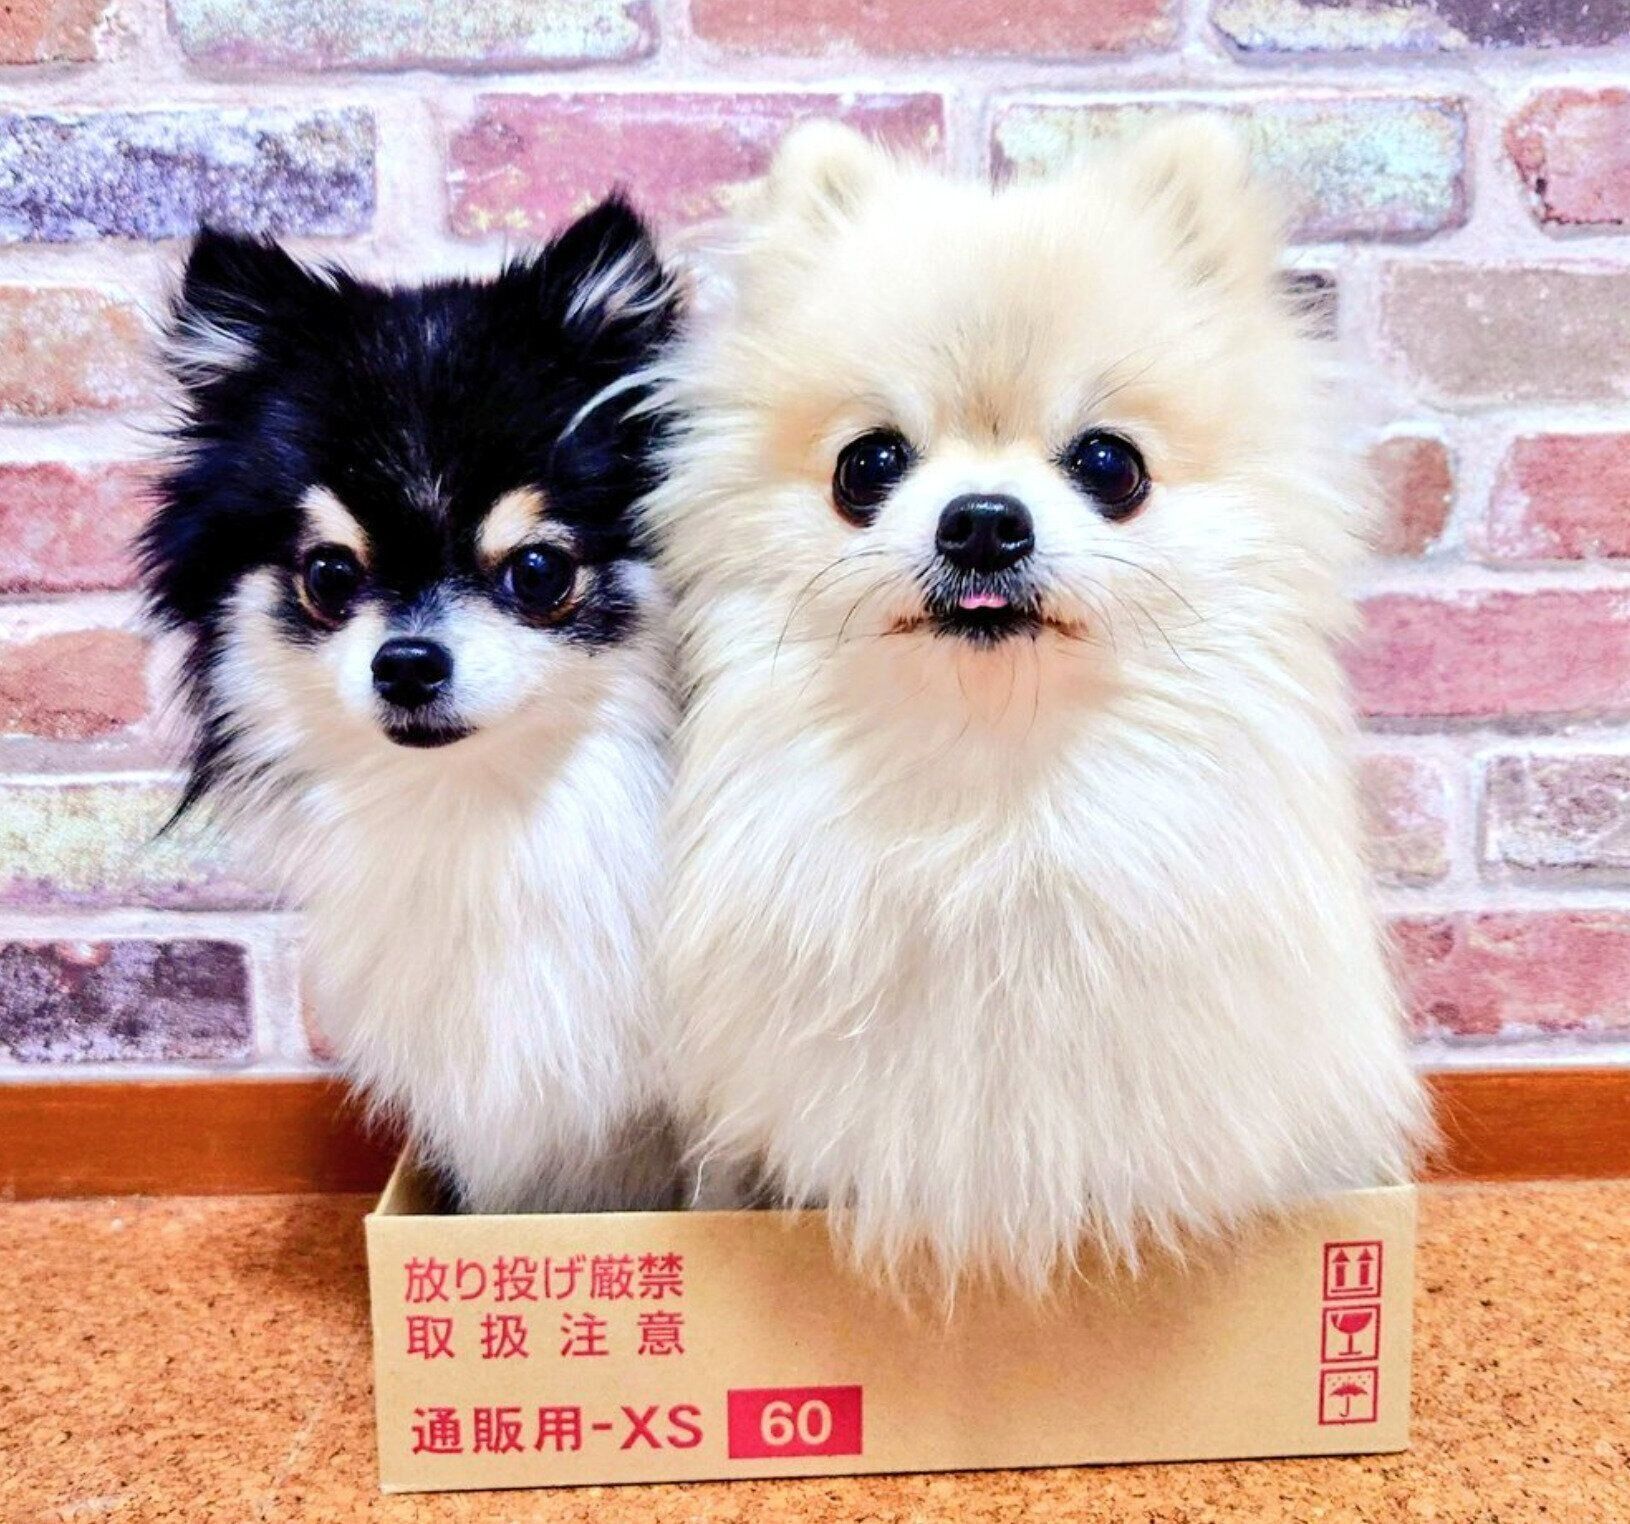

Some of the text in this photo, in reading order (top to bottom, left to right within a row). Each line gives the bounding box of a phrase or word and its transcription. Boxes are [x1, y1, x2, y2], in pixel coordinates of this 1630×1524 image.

[404, 1253, 684, 1303] 放り投げ厳禁
[406, 1310, 685, 1360] 取扱注意
[411, 1403, 704, 1455] 通販用-XS
[759, 1399, 833, 1447] 60
